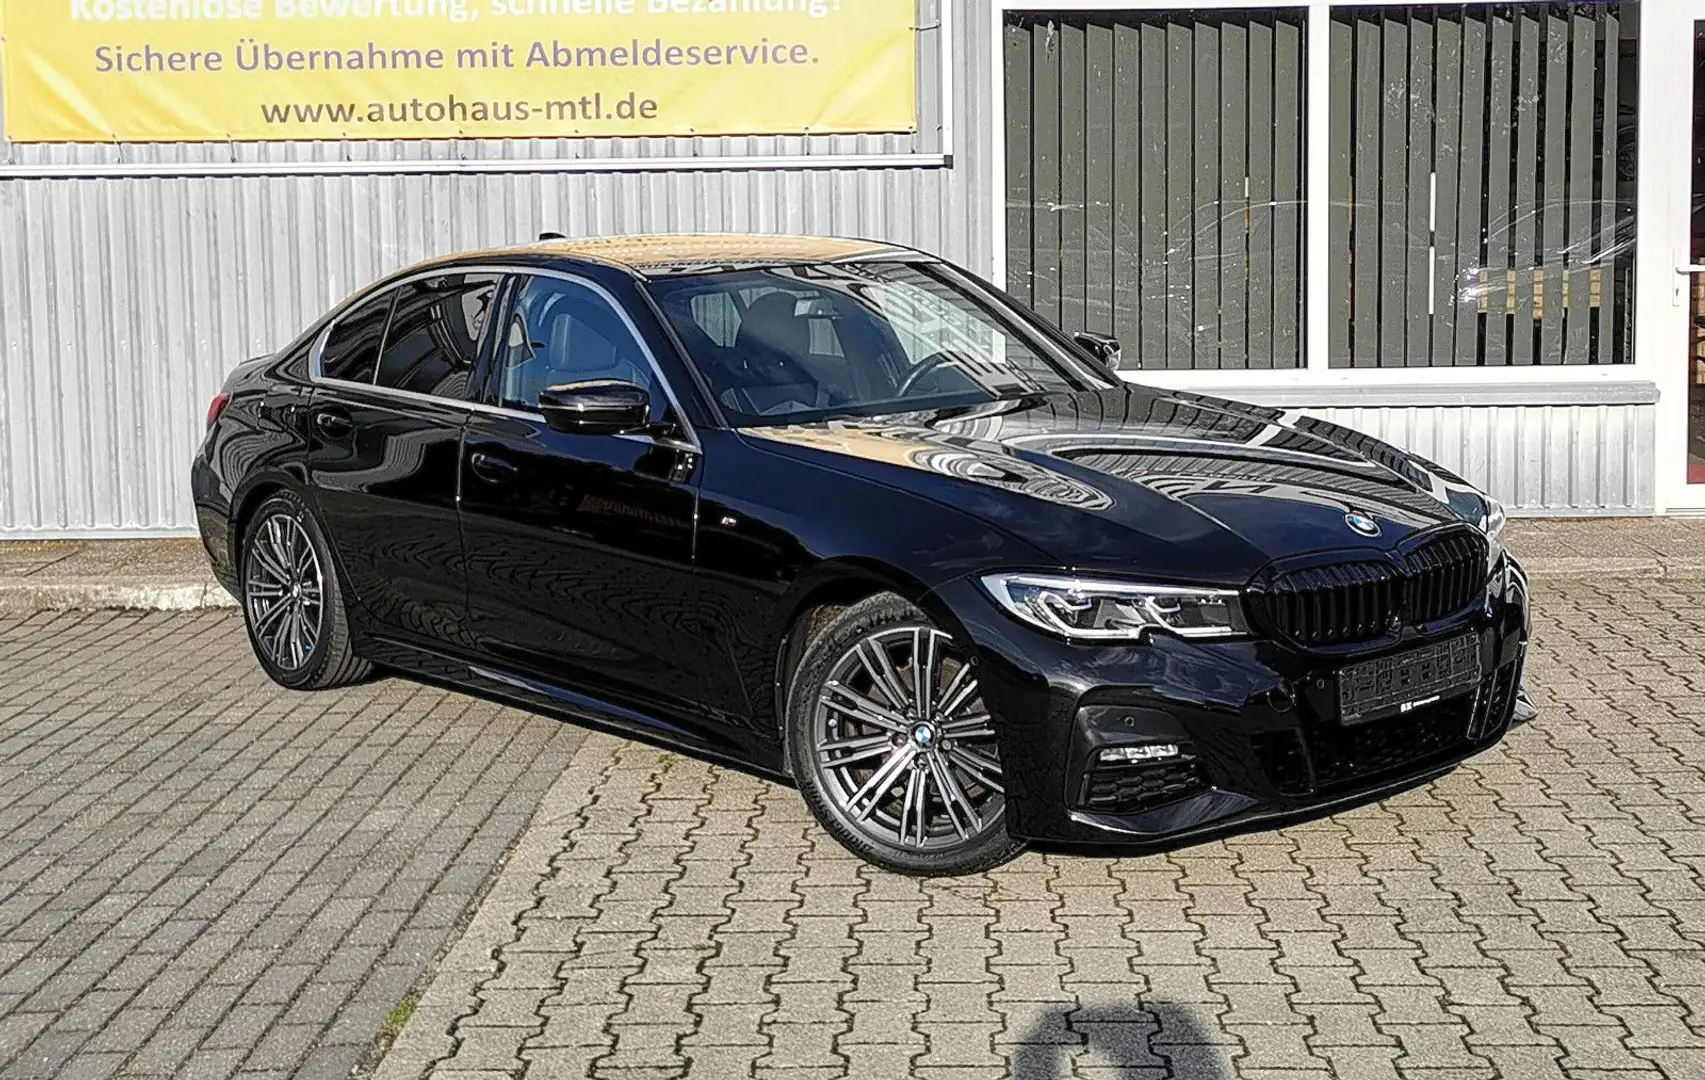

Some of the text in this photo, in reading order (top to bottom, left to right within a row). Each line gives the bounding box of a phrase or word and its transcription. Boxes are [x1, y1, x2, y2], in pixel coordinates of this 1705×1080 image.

[71, 0, 263, 22] Kostenlose
[275, 0, 480, 23] Bewertung,
[94, 37, 820, 72] Sichere Übernahme mit Abmeldeservice.
[260, 92, 658, 123] www.autohaus-mtl.de
